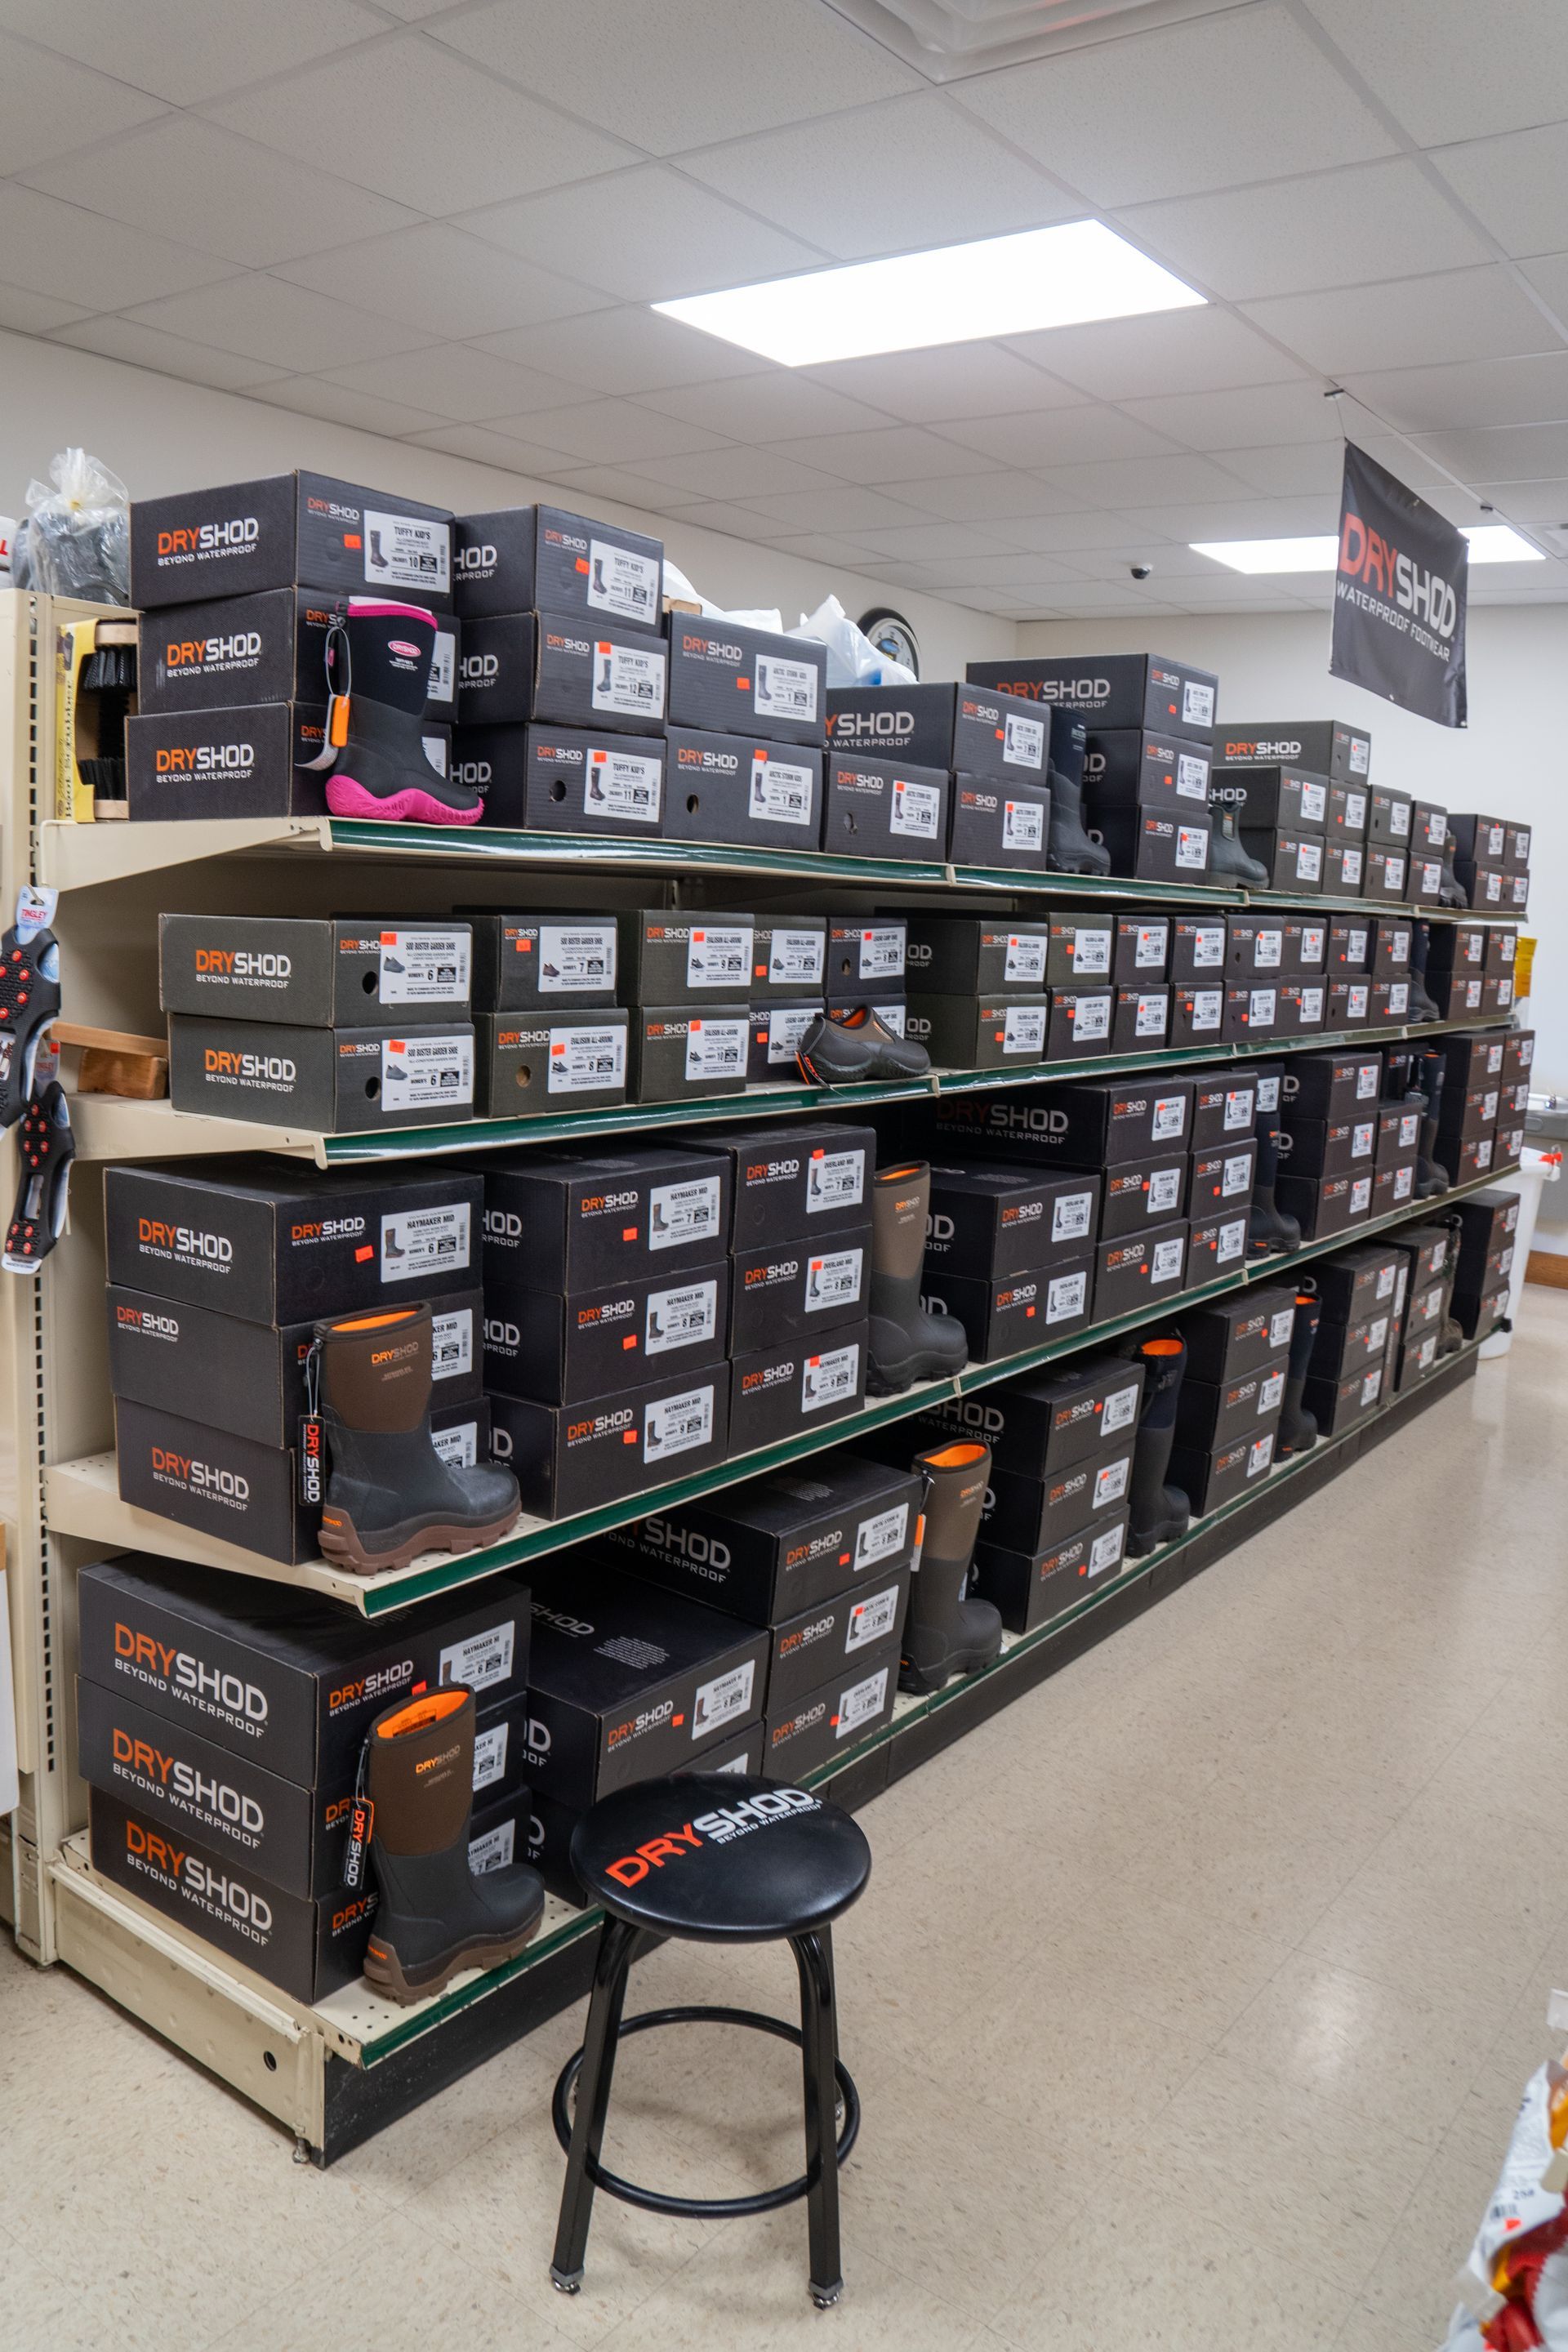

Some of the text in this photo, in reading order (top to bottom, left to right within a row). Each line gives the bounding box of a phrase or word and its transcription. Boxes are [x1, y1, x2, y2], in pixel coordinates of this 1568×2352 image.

[307, 497, 359, 520] DRYSHOD
[158, 518, 258, 555] DRYSHOD
[394, 526, 430, 540] TUFFY KID'S
[545, 529, 587, 550] DRYSHOD
[158, 544, 257, 566] BEYOND WATERPROOF
[410, 557, 418, 568] 10
[1339, 512, 1455, 639] DRYSHOD
[1337, 580, 1450, 662] WATERPROOF FOOTWEAR
[167, 632, 261, 666] DRYSHOD
[546, 634, 590, 653] DRYSHOD
[683, 635, 742, 661] DRYSHOD
[167, 658, 259, 678] BEYOND WATERPROOF
[683, 650, 741, 666] BEYOND WATERPROOF
[1152, 669, 1180, 686] DRYSHOD
[963, 701, 999, 721] DRYSHOD
[833, 737, 911, 747] WATERPROOF
[1226, 741, 1301, 755] DRYSHOD
[157, 744, 254, 772] DRYSHOD
[537, 746, 582, 761] DRYSHOD
[678, 749, 738, 769] DRYSHOD
[157, 770, 253, 782] BEYOND WATERPROOF
[678, 764, 736, 776] BEYOND WATERPROOF
[837, 771, 884, 790] DRYSHOD
[960, 791, 997, 808] DRYSHOD
[21, 909, 47, 921] TINGLEY
[505, 929, 537, 938] DRYSHOD
[647, 927, 689, 939] DRYSHOD
[196, 950, 291, 977] DRYSHOD
[579, 963, 585, 972] 7
[197, 974, 288, 989] BEYOND WATERPROOF
[428, 970, 434, 980] 6
[498, 1031, 550, 1044] DRYSHOD
[647, 1023, 688, 1036] DRYSHOD
[340, 1044, 380, 1054] DRYSHOD
[416, 1048, 431, 1056] BUSTER
[433, 1047, 447, 1055] GARDEN
[205, 1049, 296, 1082] DRYSHOD
[589, 1061, 594, 1071] 8
[206, 1073, 294, 1093] BEYOND WATERPROOF
[431, 1075, 436, 1085] 6
[937, 1099, 1069, 1133] DRYSHOD
[1113, 1099, 1147, 1114] DRYSHOD
[936, 1123, 1066, 1144] BEYOND WATERPROOF
[746, 1159, 800, 1180] DRYSHOD
[746, 1173, 797, 1186] BEYOND WATERPROOF
[1110, 1174, 1143, 1192] DRYSHOD
[581, 1191, 639, 1212] DRYSHOD
[581, 1204, 637, 1218] BEYOND WATERPROOF
[1002, 1202, 1043, 1222] DRYSHOD
[292, 1216, 365, 1240] DRYSHOD
[408, 1215, 455, 1228] HAYMAKER MID
[687, 1214, 692, 1223] 7
[139, 1218, 232, 1263] DRYSHOD
[292, 1231, 363, 1247] BEYOND WATERPROOF
[429, 1243, 434, 1254] 6
[139, 1244, 230, 1275] BEYOND WATERPROOF
[1107, 1244, 1145, 1266] DRYSHOD
[745, 1260, 798, 1284] DRYSHOD
[745, 1274, 797, 1290] BEYOND WATERPROOF
[996, 1284, 1036, 1307] DRYSHOD
[117, 1306, 179, 1335] DRYSHOD
[578, 1299, 635, 1324] DRYSHOD
[578, 1312, 634, 1330] BEYOND WATERPROOF
[118, 1321, 178, 1343] BEYOND WATERPROOF
[447, 1321, 457, 1330] MID
[683, 1318, 687, 1327] 8
[371, 1341, 419, 1365] DRYSHOD
[742, 1362, 794, 1389] DRYSHOD
[742, 1377, 793, 1396] BEYOND WATERPROOF
[1055, 1400, 1095, 1425] DRYSHOD
[568, 1409, 633, 1441] DRYSHOD
[568, 1423, 631, 1447] BEYOND WATERPROOF
[451, 1435, 461, 1445] MID
[152, 1447, 249, 1499] DRYSHOD
[307, 1424, 319, 1503] DRYSHOD
[154, 1472, 248, 1512] BEYOND WATERPROOF
[1049, 1473, 1087, 1502] DRYSHOD
[786, 1530, 843, 1565] DRYSHOD
[639, 1544, 727, 1583] WATERPROOF
[786, 1557, 808, 1571] BEYOND
[1041, 1543, 1084, 1575] DRYSHOD
[780, 1615, 835, 1653] DRYSHOD
[463, 1636, 499, 1656] HAYMAKER HI
[115, 1623, 268, 1722] DRYSHOD
[479, 1665, 483, 1673] 6
[329, 1659, 414, 1709] DRYSHOD
[115, 1658, 265, 1738] BEYOND WATERPROOF
[329, 1675, 412, 1717] BEYOND WATERPROOF
[608, 1700, 674, 1745] DRYSHOD
[773, 1703, 826, 1744] DRYSHOD
[608, 1717, 673, 1753] BEYOND WATERPROOF
[416, 1745, 461, 1774] DRYSHOD
[114, 1728, 264, 1833] DRYSHOD
[114, 1762, 261, 1851] BEYOND WATERPROOF
[717, 1799, 822, 1845] BEYOND WATERPROOF
[348, 1809, 365, 1887] DRYSHOD
[605, 1788, 815, 1888] DRYSHOD
[127, 1820, 272, 1931] DRYSHOD
[127, 1853, 269, 1947] BEYOND WATERPROOF
[332, 1915, 363, 1937] BEYOND
